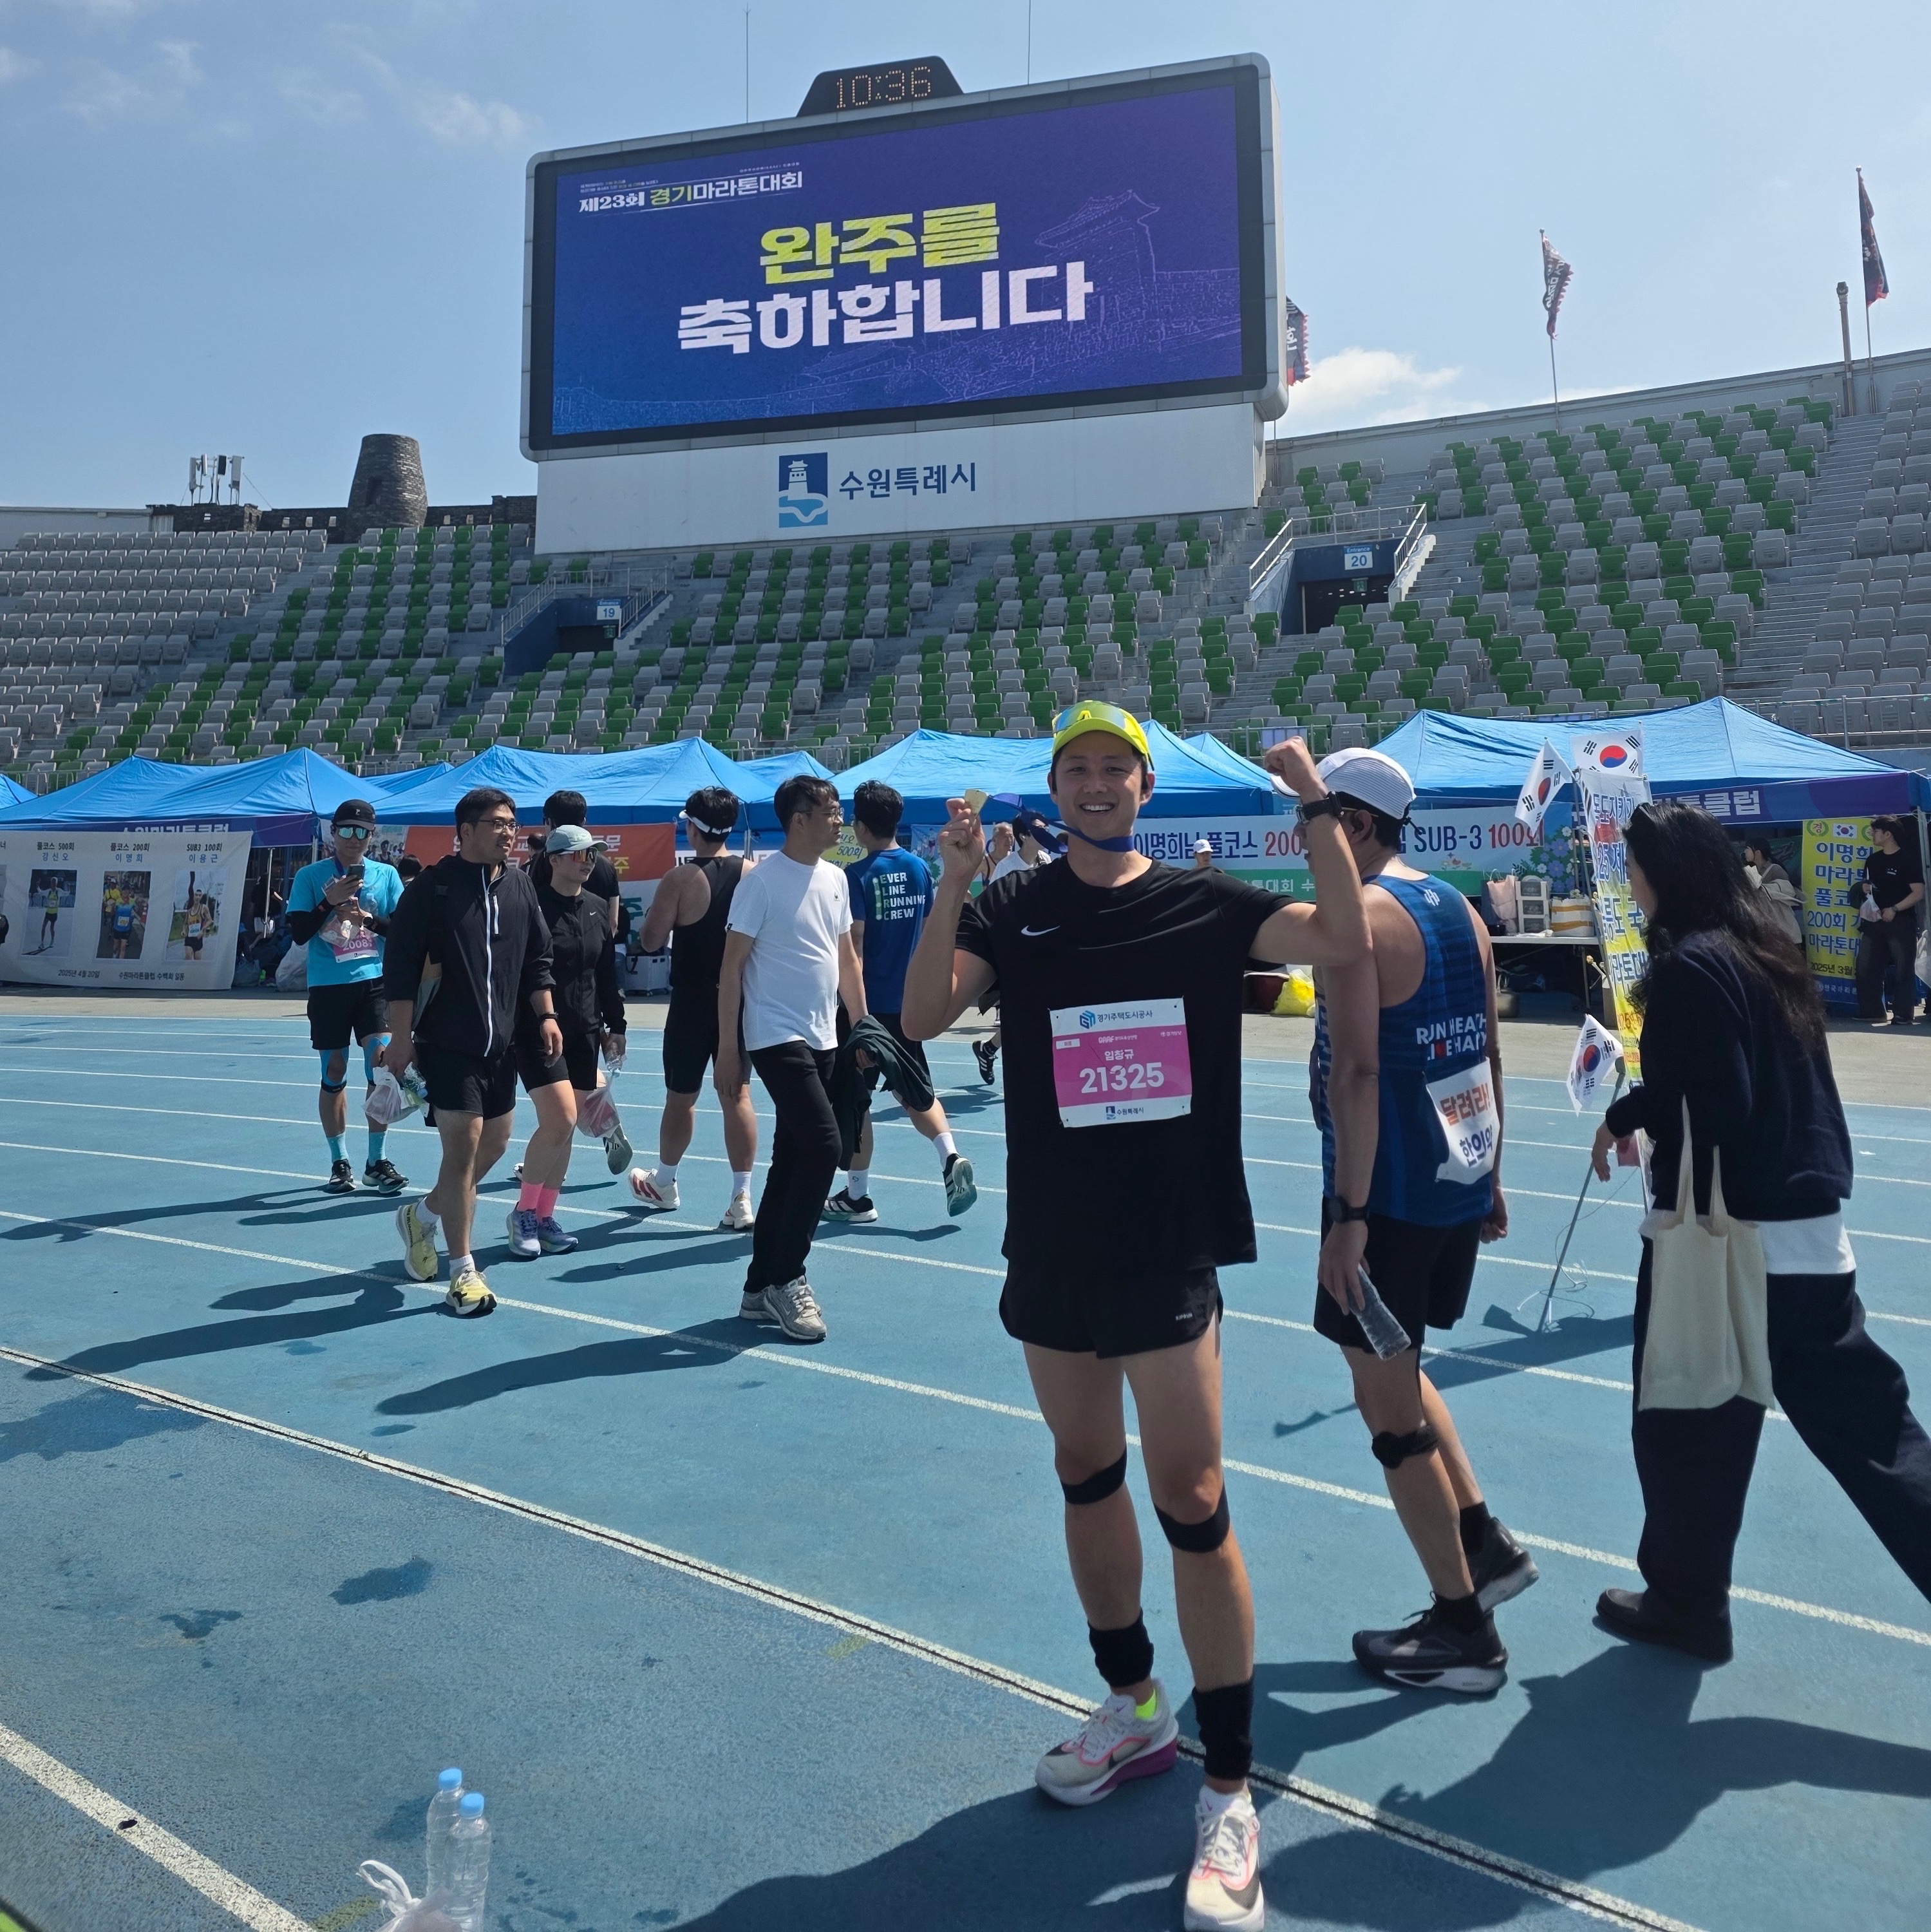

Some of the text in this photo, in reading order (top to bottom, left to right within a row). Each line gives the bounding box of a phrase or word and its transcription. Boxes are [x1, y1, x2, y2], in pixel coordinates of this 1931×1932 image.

[836, 66, 931, 108] 10:36
[579, 191, 645, 213] 제23회
[650, 171, 802, 206] 경기마라톤대회
[760, 202, 999, 284] 완주를
[677, 261, 1093, 354] 축하합니다
[839, 462, 975, 500] 수원특례시
[1352, 555, 1367, 567] 20
[603, 607, 615, 618] 19
[37, 842, 75, 851] 풀코스 500회
[110, 843, 150, 851] 풀코스 200회
[187, 843, 223, 852] SUB3 100회
[1207, 830, 1258, 859] 풀코스
[1265, 831, 1303, 857] 200
[1414, 824, 1482, 853] SUB-3
[836, 846, 863, 859] 500회
[880, 872, 908, 884] EVER
[882, 884, 906, 896] LINE
[1251, 878, 1294, 893] 톤대회
[883, 895, 926, 909] RUNNING
[1814, 887, 1851, 907] 풀코
[883, 907, 914, 920] CREW
[1807, 911, 1846, 933] 200회
[1809, 934, 1861, 957] 마라톤대
[58, 969, 77, 978] 2025년
[118, 971, 155, 980] 수원마라톤클럽
[1838, 965, 1852, 976] 3월
[1097, 1010, 1153, 1023] 경기주택도시공사
[1104, 1048, 1135, 1061] 임창규
[1079, 1062, 1165, 1094] 21325
[1116, 1106, 1144, 1115] 수원특례시
[1440, 1083, 1491, 1126] 달려라!
